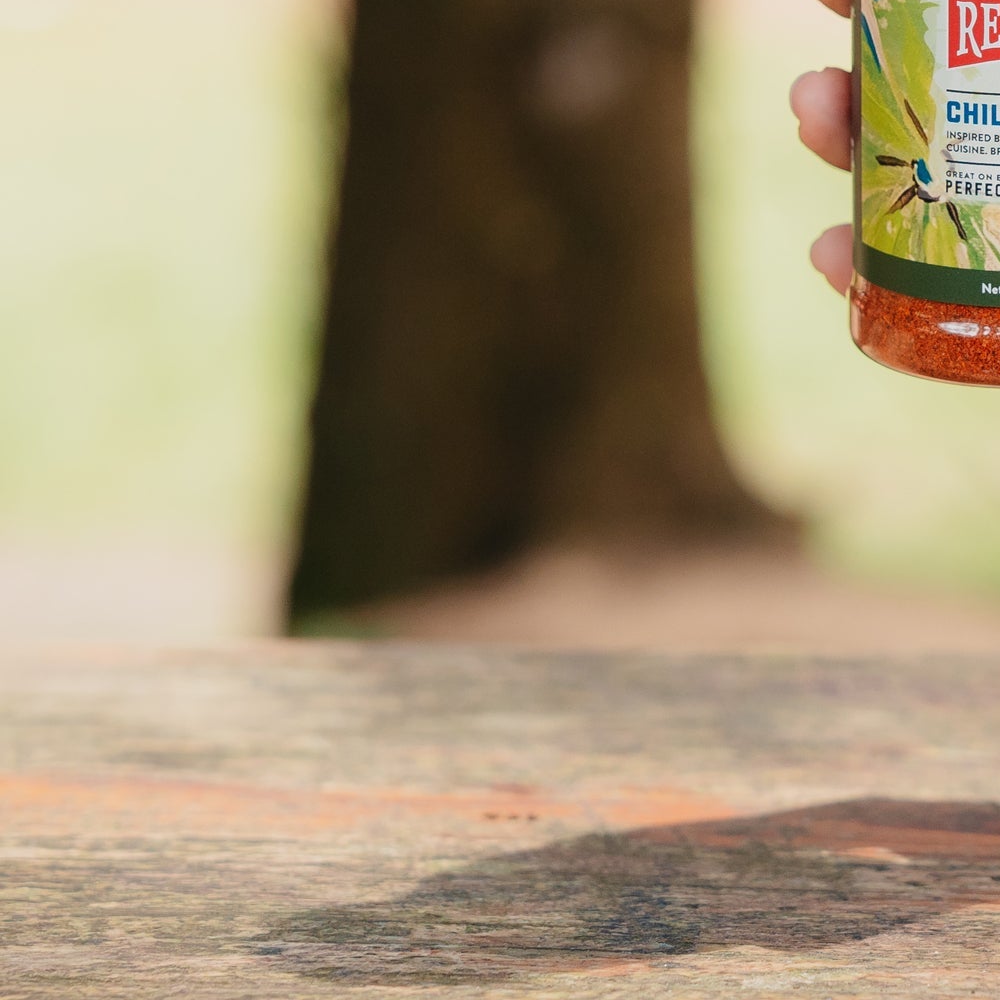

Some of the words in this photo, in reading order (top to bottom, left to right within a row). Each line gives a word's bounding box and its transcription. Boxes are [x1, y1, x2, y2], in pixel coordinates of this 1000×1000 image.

[946, 131, 992, 143] INSPIRED
[946, 143, 988, 155] CUISINE.
[946, 170, 975, 180] GREAT
[978, 173, 993, 181] ON
